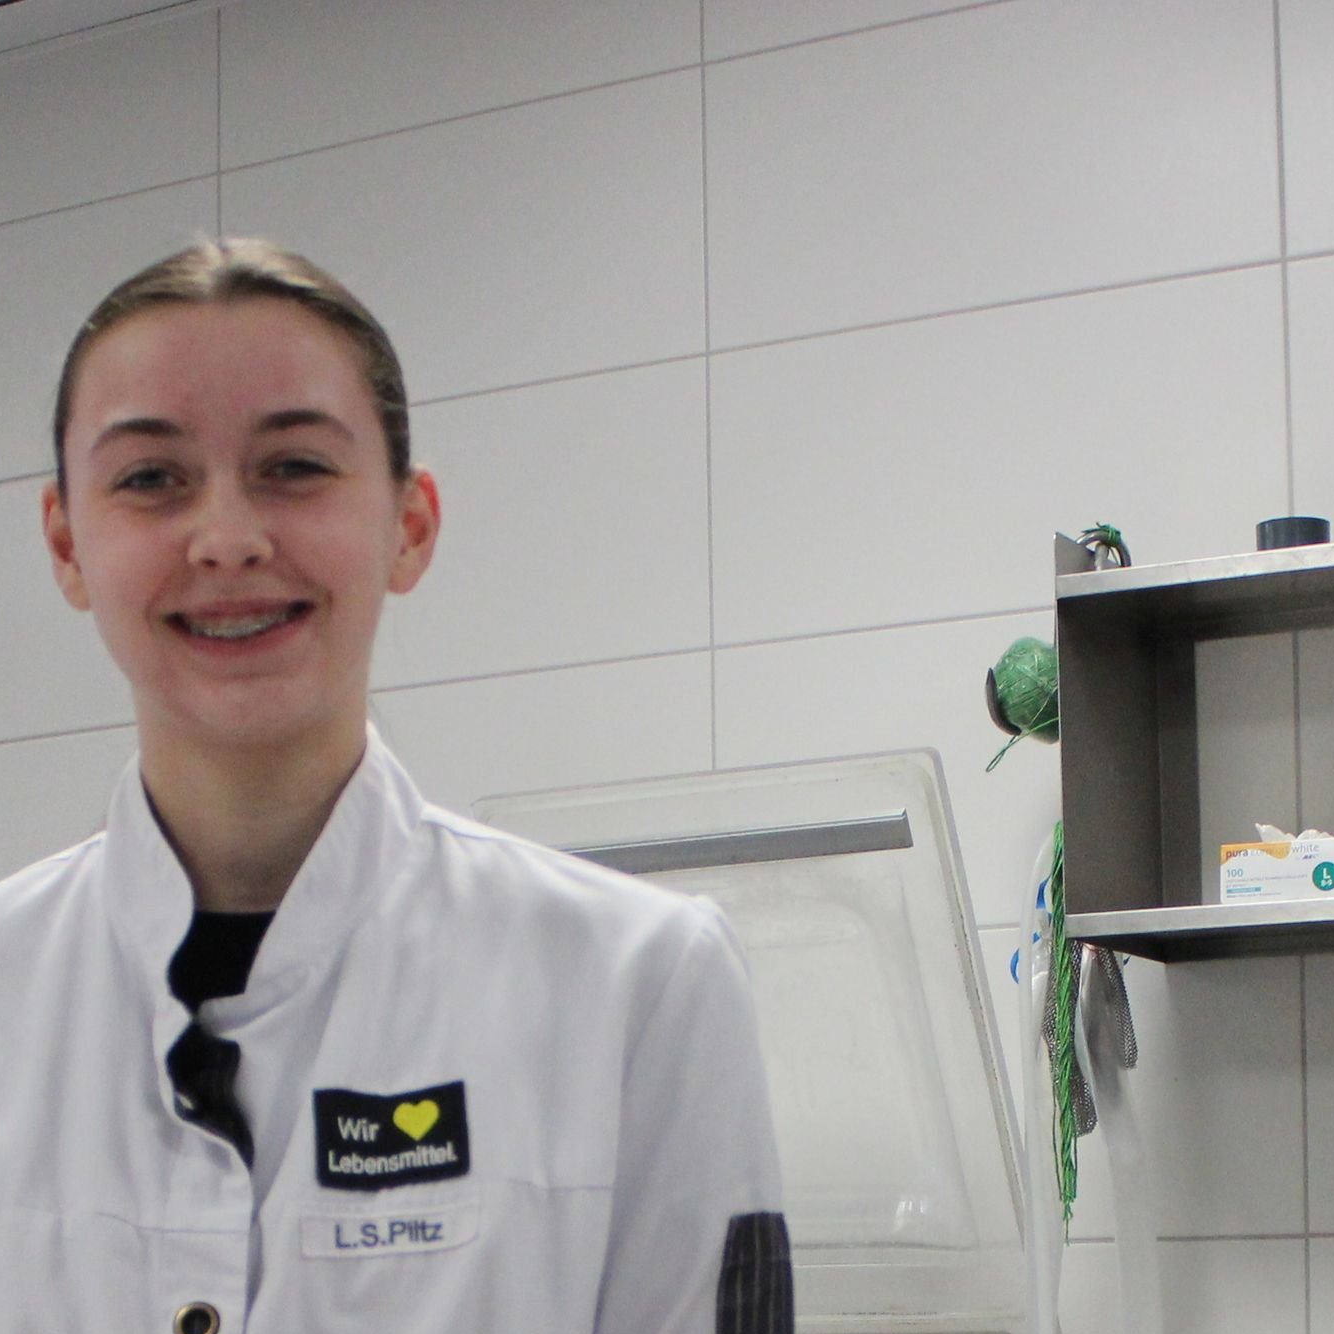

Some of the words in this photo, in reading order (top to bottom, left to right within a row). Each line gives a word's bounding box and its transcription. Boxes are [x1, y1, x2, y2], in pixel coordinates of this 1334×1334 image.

[1226, 849, 1249, 859] pura
[1292, 842, 1320, 854] white
[1227, 868, 1244, 878] 100
[1323, 867, 1331, 879] L
[337, 1116, 380, 1142] Wir
